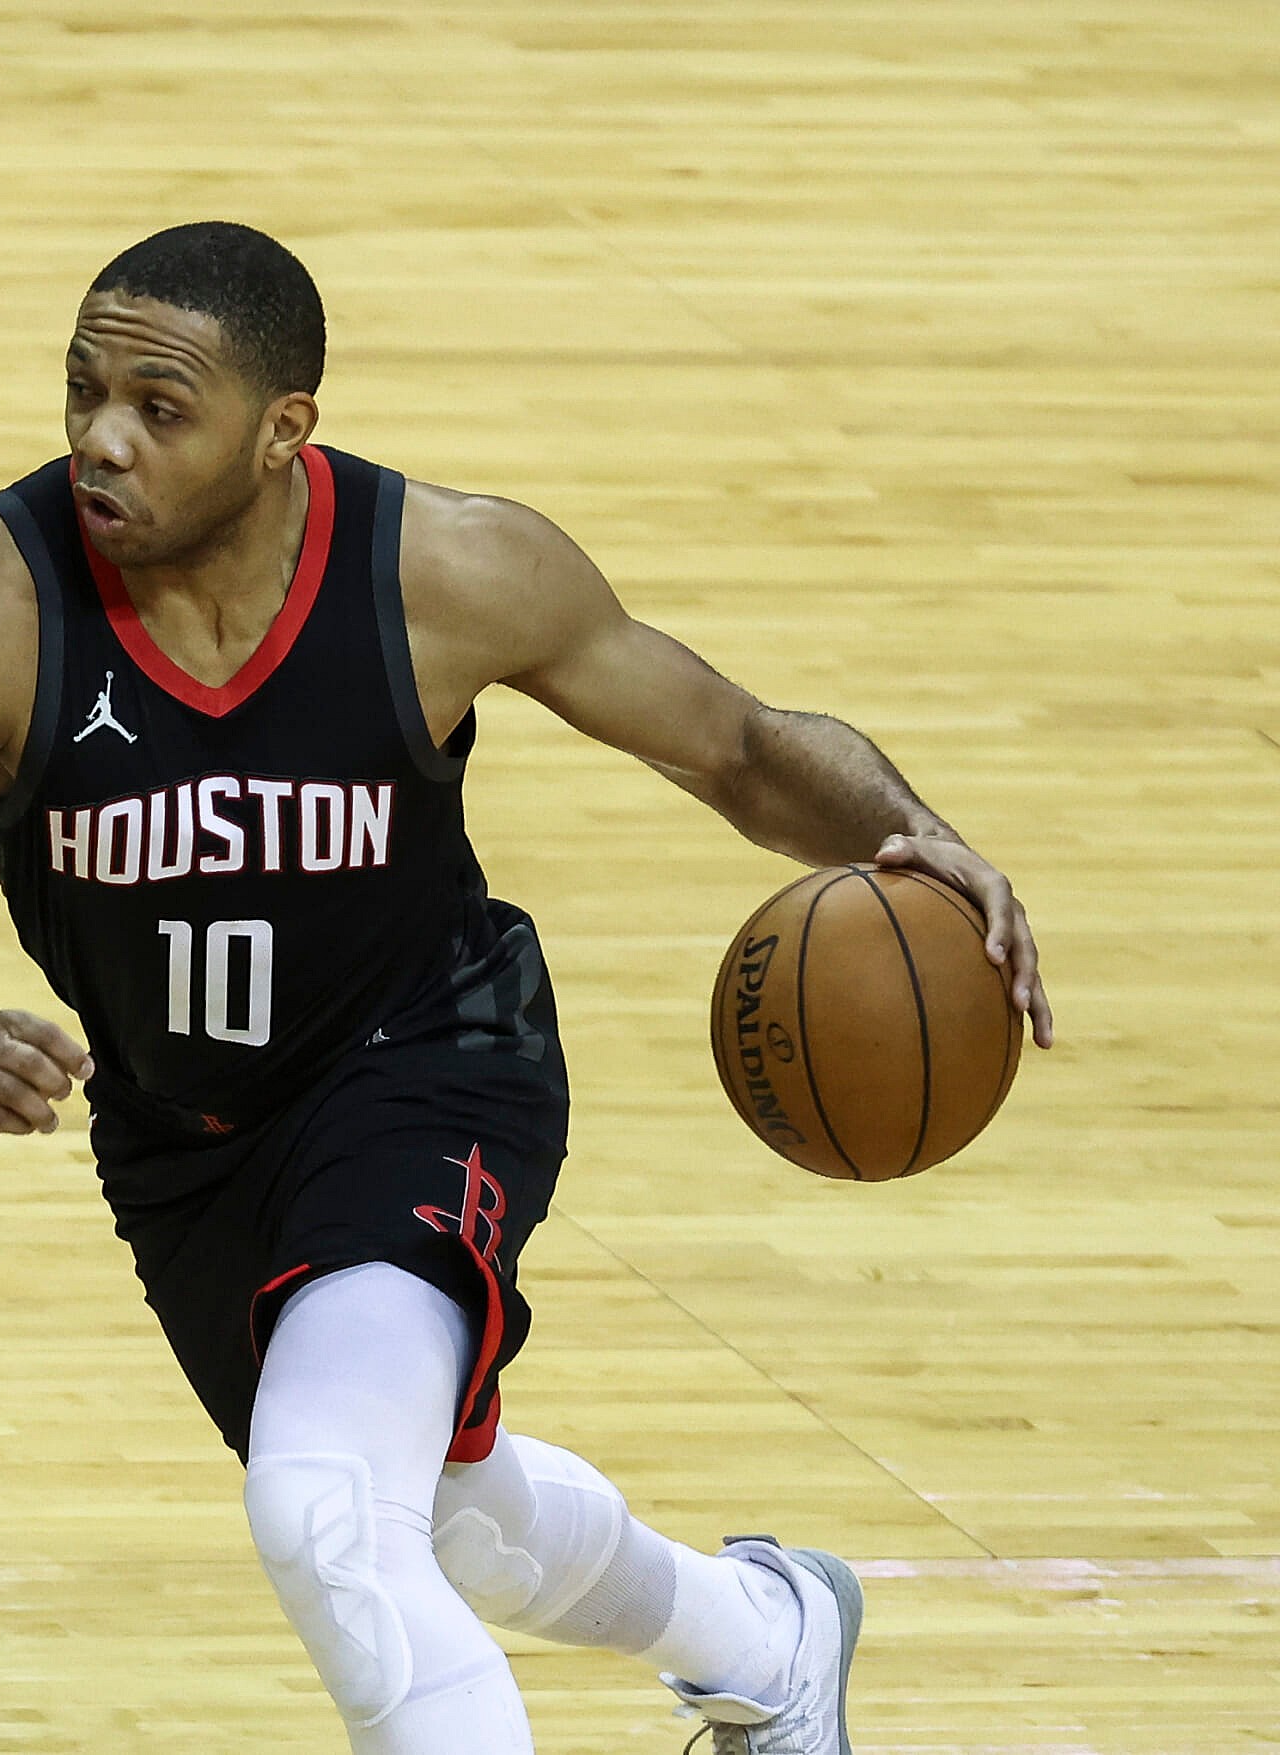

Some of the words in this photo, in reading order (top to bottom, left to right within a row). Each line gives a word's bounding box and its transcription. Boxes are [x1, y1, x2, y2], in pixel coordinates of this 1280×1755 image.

[47, 772, 395, 886] HOUSTON
[158, 919, 273, 1048] 10
[736, 933, 808, 1145] SPALDING
